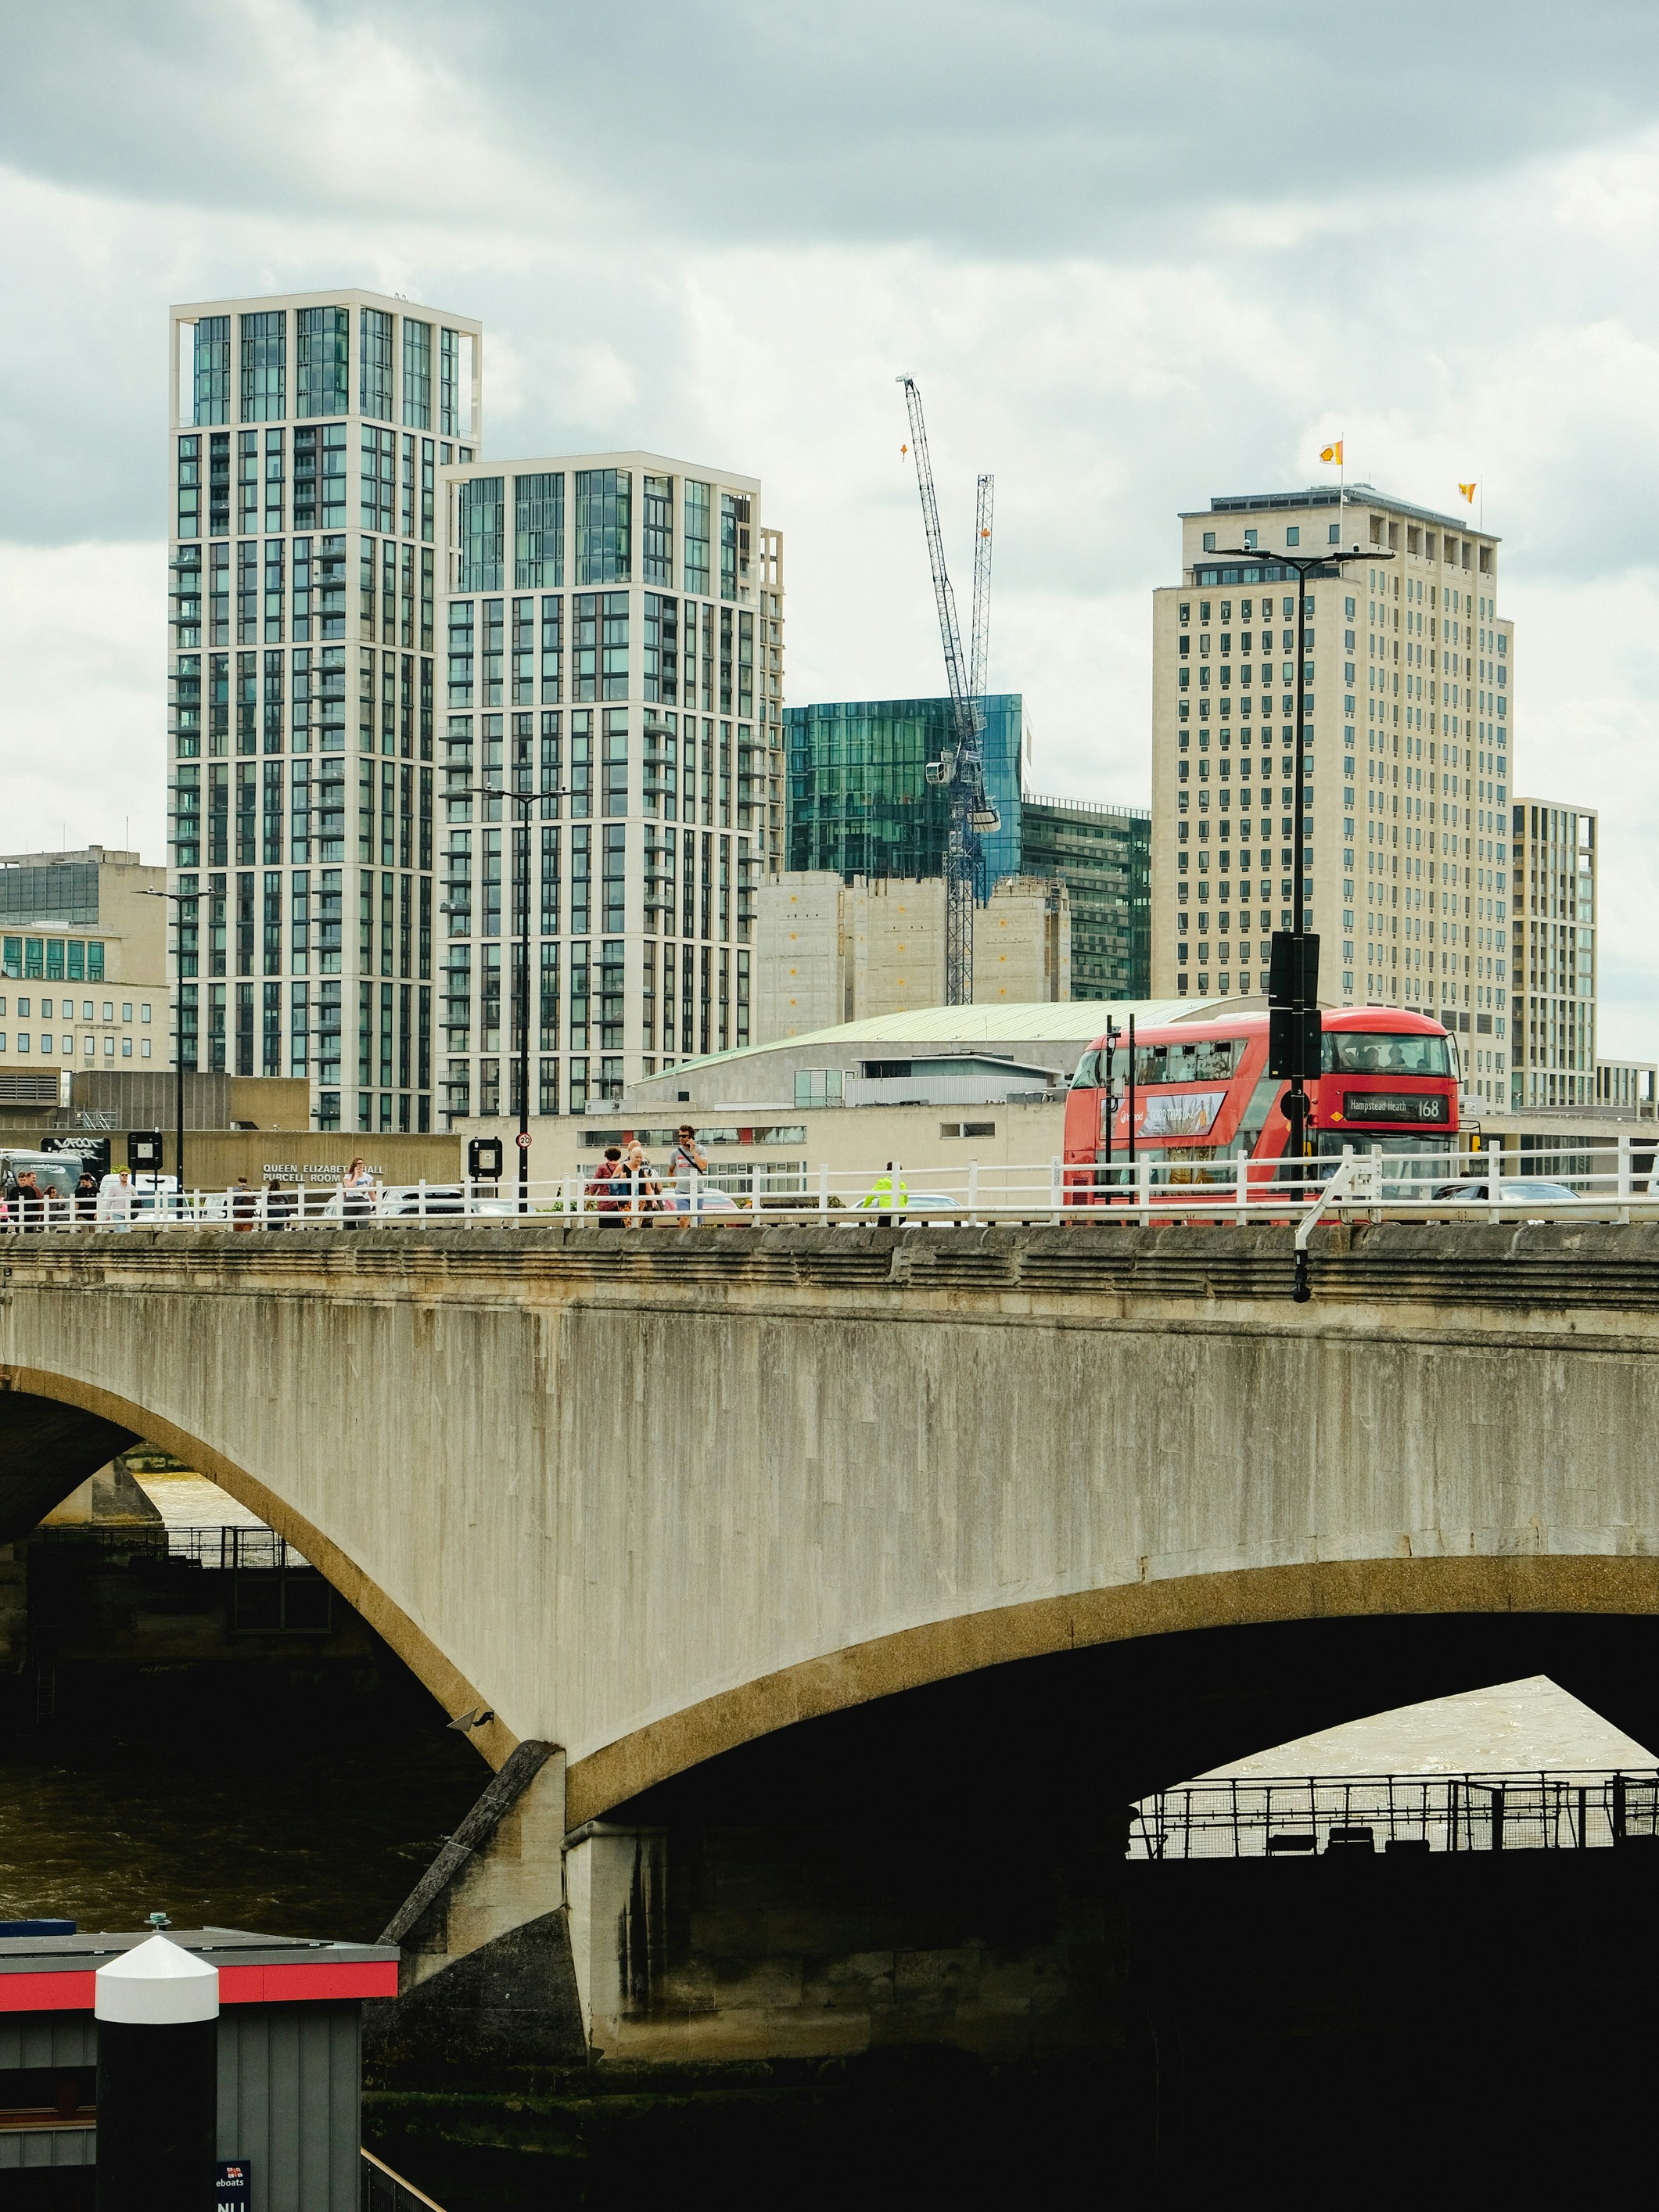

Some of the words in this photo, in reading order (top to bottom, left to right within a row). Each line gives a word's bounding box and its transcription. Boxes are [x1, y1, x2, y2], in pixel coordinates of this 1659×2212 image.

[1351, 1099, 1386, 1113] Hampstead
[1388, 1101, 1406, 1111] Heath
[1419, 1101, 1439, 1118] 168
[263, 1164, 297, 1172] QUEEN
[303, 1165, 350, 1173] ELIZABET
[263, 1173, 306, 1182] PURCELL
